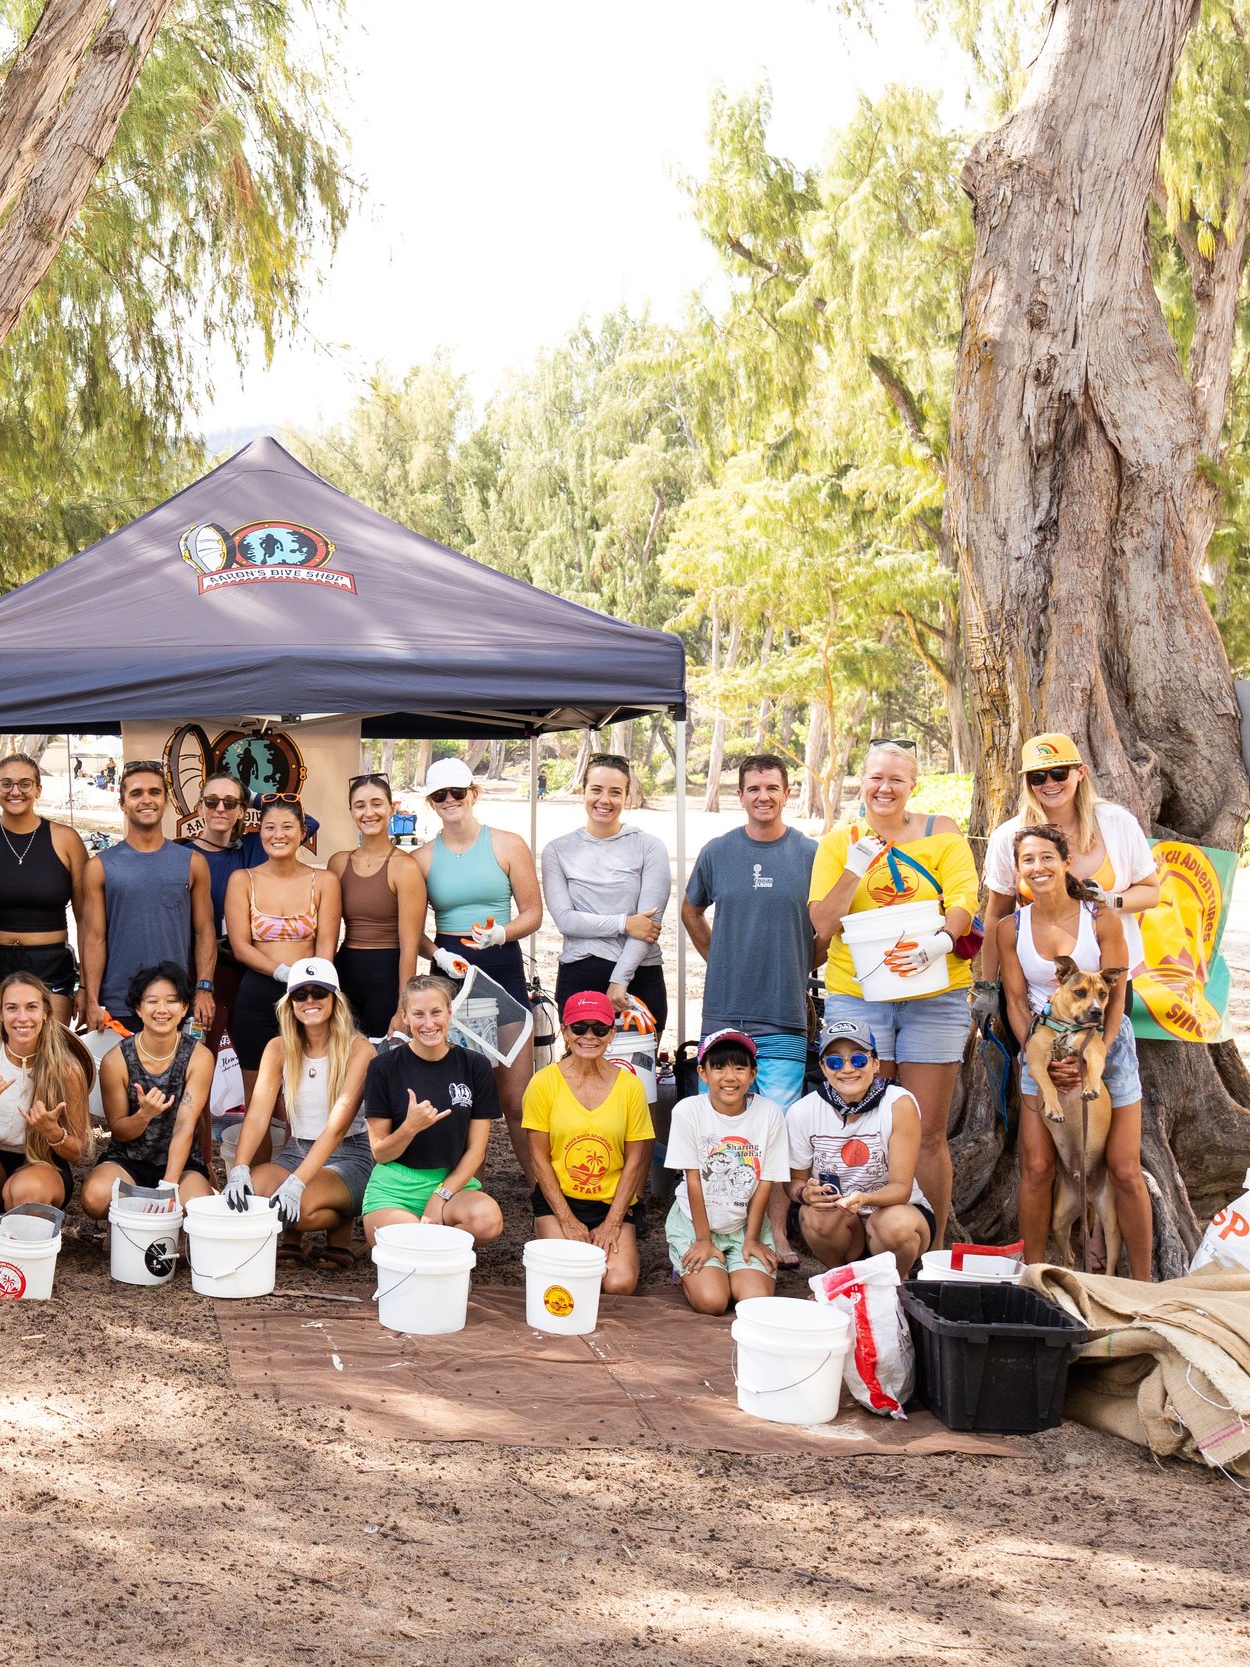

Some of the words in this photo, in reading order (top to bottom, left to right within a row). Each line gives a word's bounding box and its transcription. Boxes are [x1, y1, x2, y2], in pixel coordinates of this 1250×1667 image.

[209, 569, 267, 584] AARON'S
[271, 569, 302, 577] DIVE
[306, 570, 344, 583] SHOP
[726, 1143, 759, 1151] Sharing
[572, 1184, 603, 1194] STAFF
